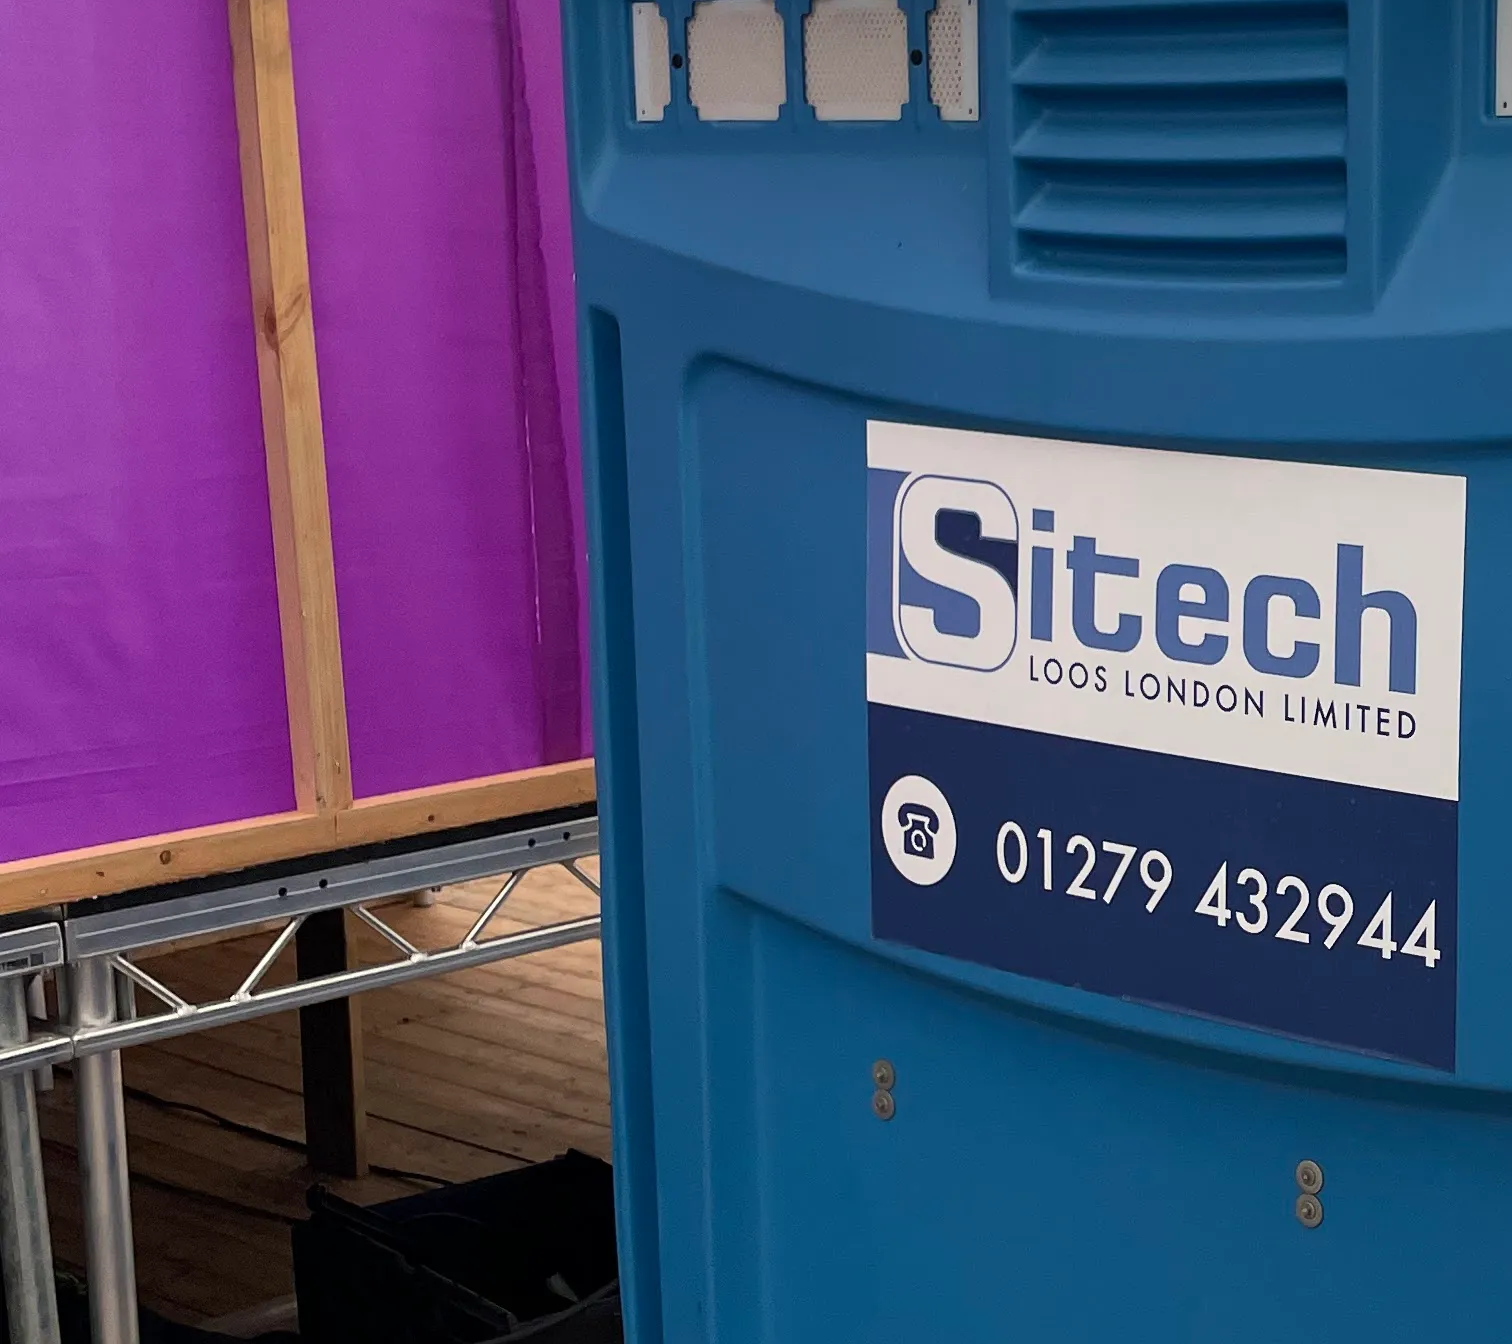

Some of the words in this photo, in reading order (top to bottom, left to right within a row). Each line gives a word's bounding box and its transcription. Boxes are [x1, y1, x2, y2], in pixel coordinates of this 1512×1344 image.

[898, 473, 1418, 696] Sitech
[1029, 655, 1107, 693] LOOS
[1125, 670, 1264, 718] LONDON
[1284, 693, 1416, 740] LIMITED
[996, 821, 1173, 913] 01279
[1194, 861, 1441, 969] 432944
